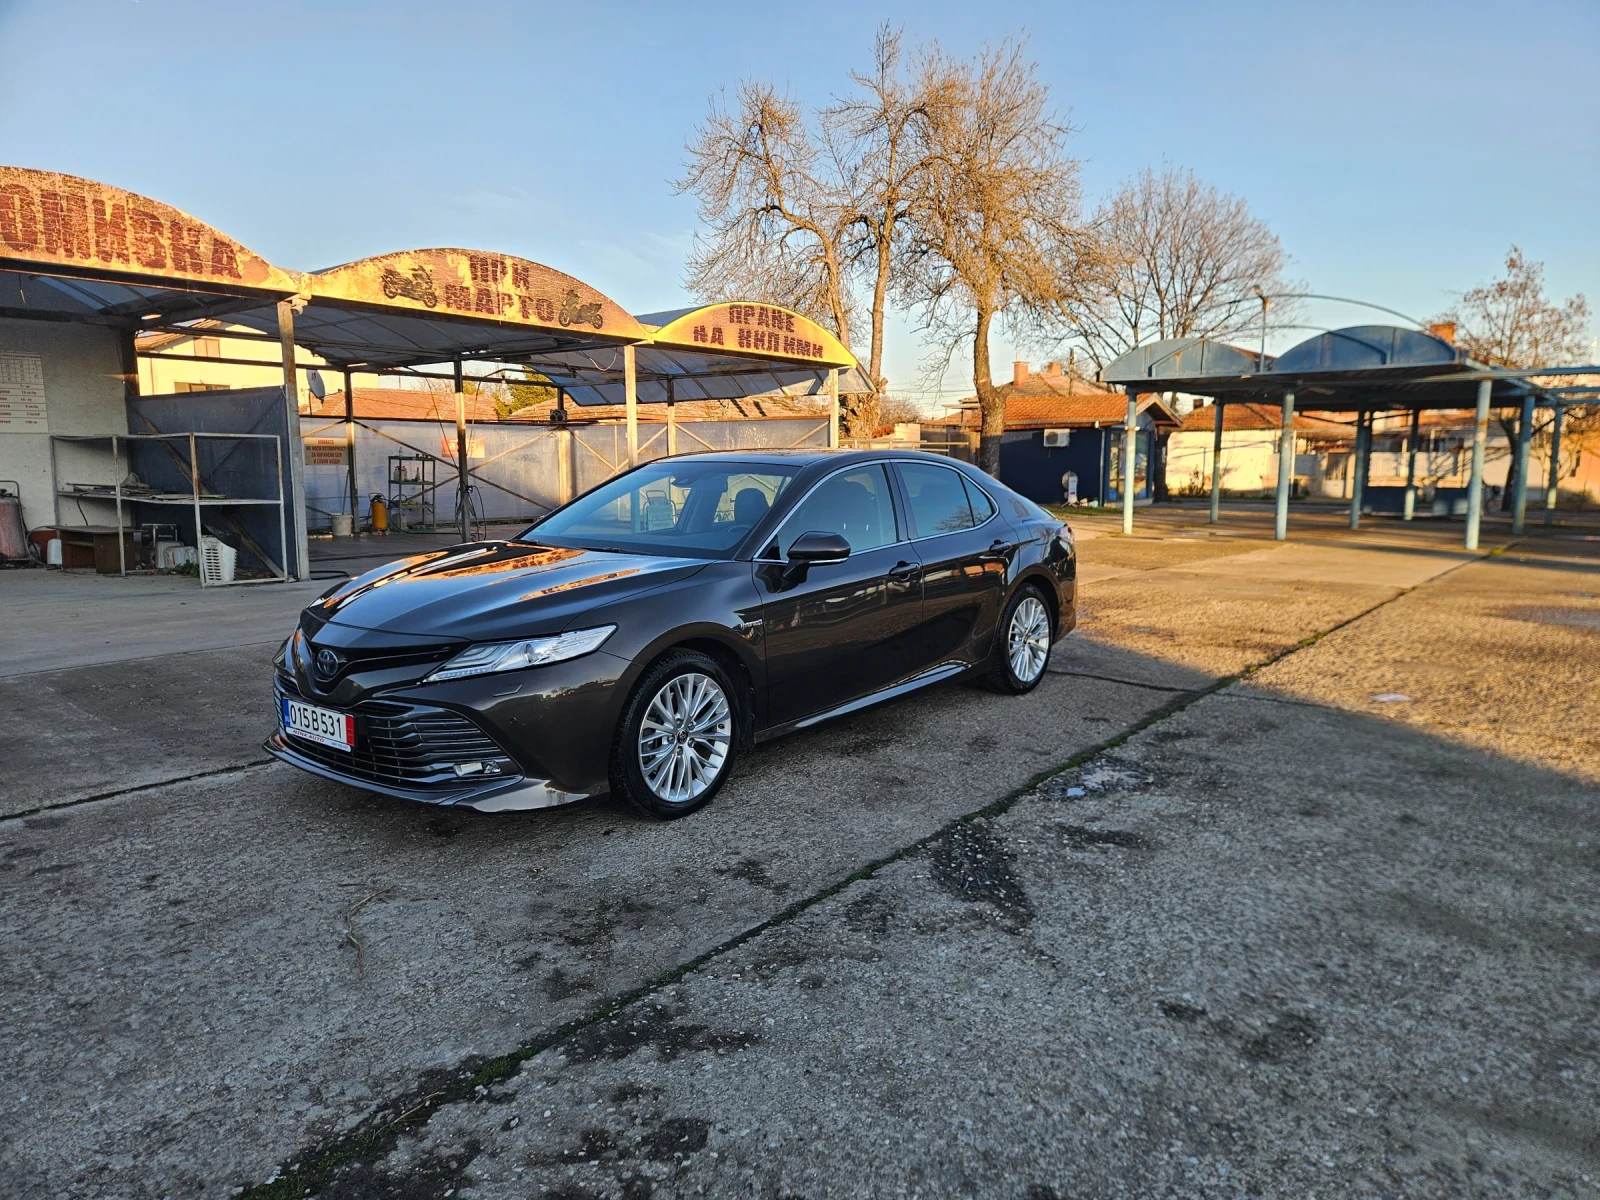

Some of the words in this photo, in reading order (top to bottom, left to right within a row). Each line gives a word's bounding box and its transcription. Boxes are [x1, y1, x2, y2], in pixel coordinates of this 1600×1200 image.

[729, 304, 795, 333] ПРАНЕ
[693, 325, 724, 346] НА
[290, 704, 342, 739] 015B531
[293, 730, 307, 738] NINA
[308, 735, 324, 743] AUTO
